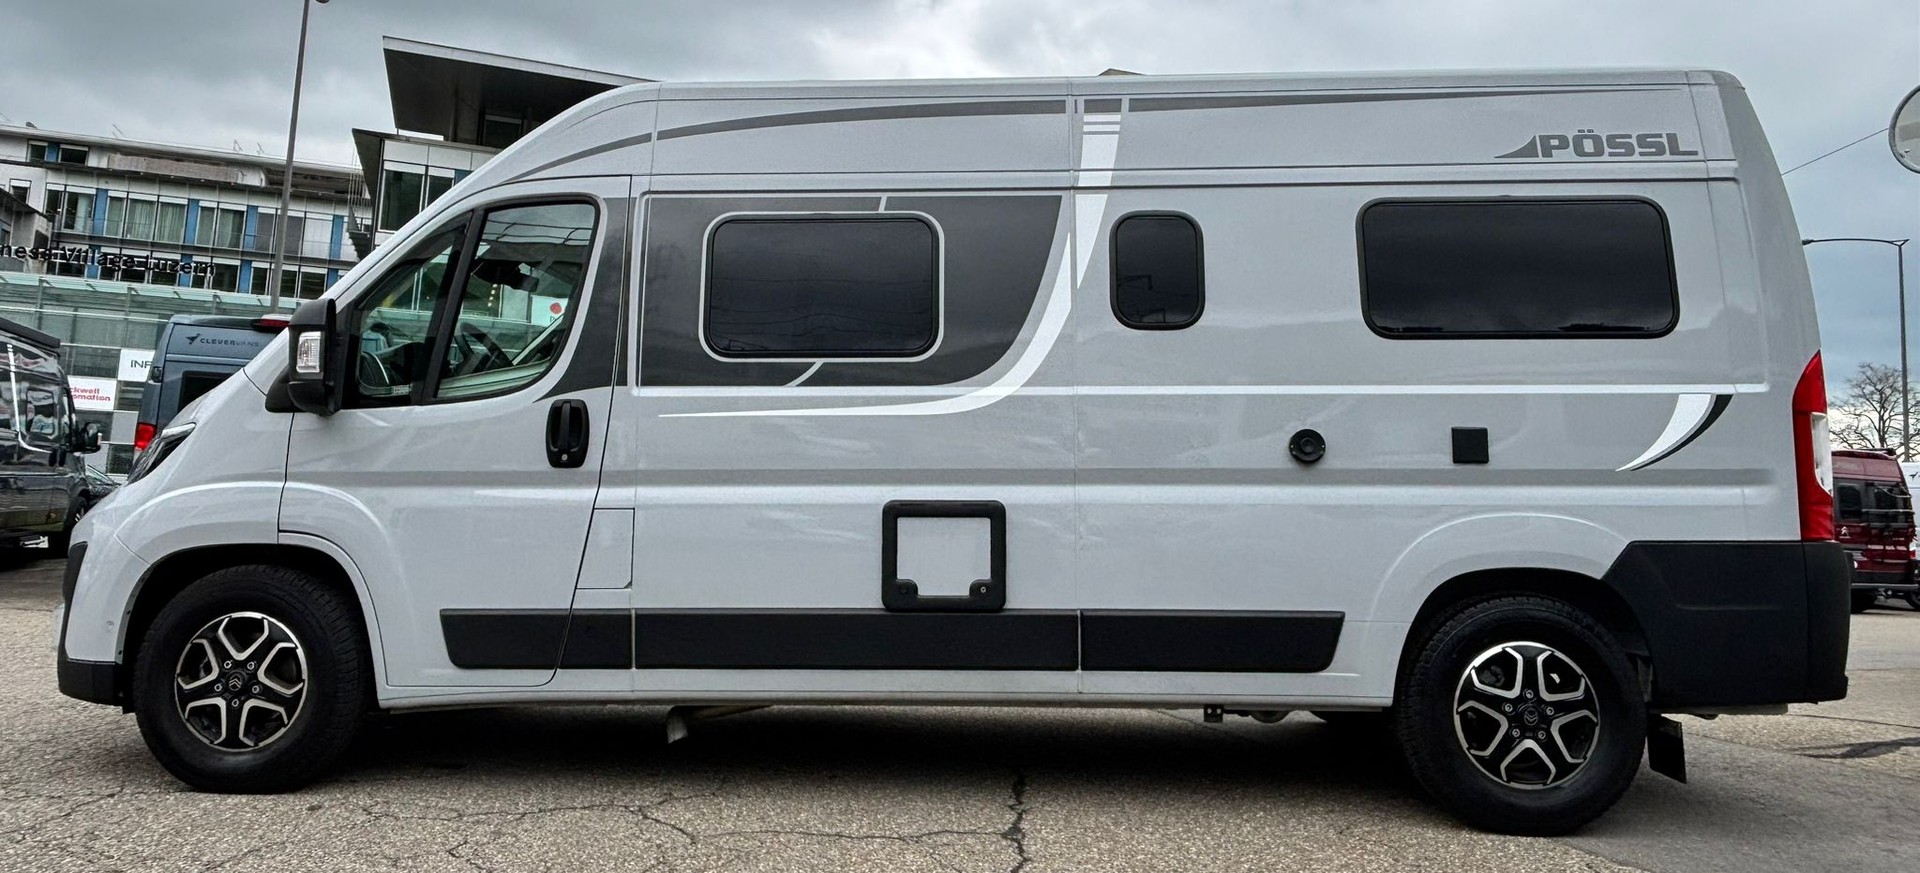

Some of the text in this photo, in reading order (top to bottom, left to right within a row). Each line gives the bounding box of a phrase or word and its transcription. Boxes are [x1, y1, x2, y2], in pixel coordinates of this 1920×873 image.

[1539, 129, 1698, 158] PÖSSL
[61, 245, 135, 271] Village
[146, 254, 216, 277] Luzern
